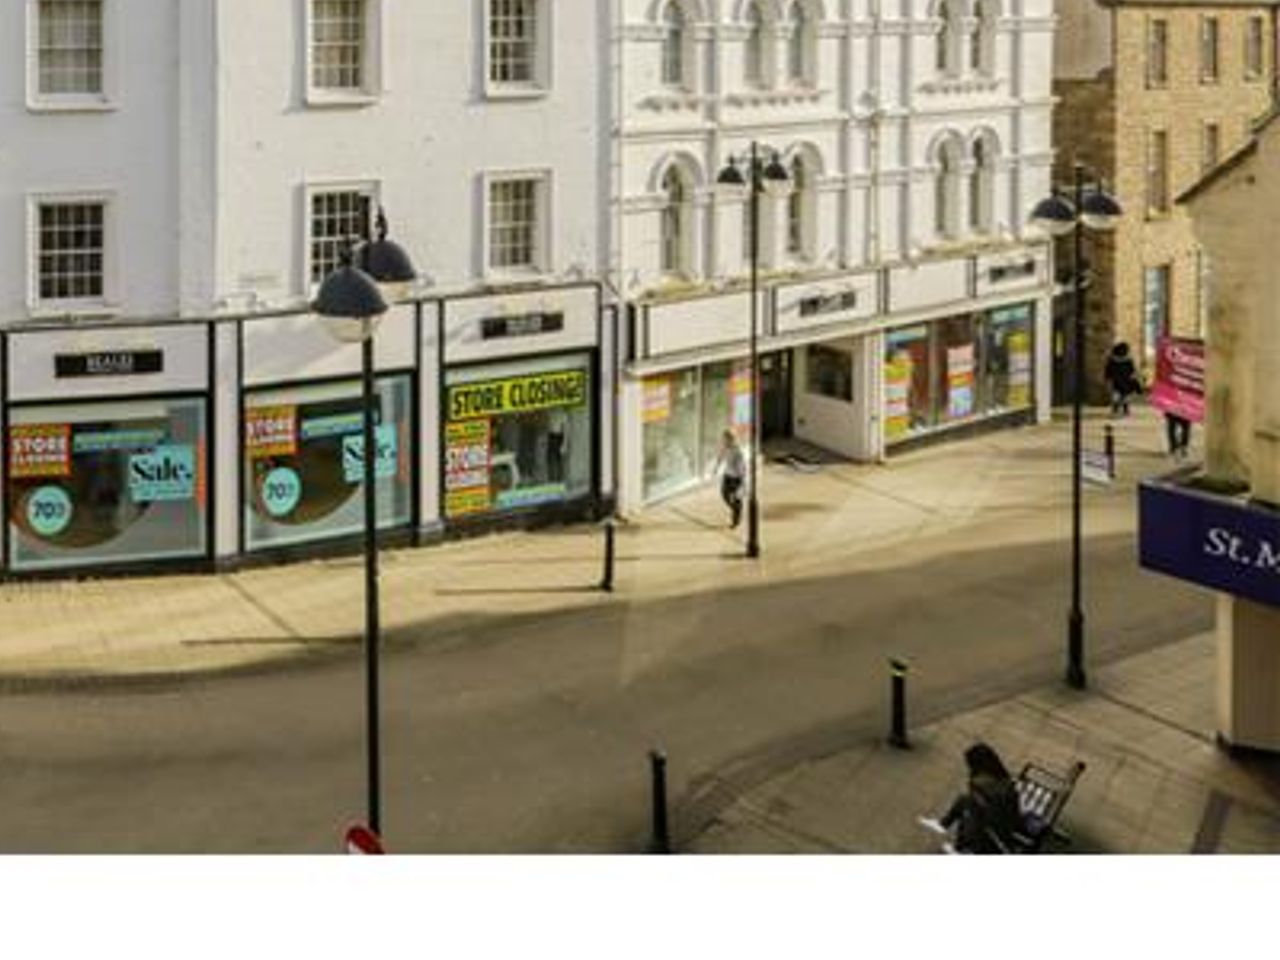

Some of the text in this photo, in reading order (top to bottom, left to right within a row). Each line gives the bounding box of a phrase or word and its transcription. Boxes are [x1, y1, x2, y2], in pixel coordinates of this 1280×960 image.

[454, 384, 503, 416] STORE
[11, 436, 67, 452] STORE
[1203, 528, 1250, 565] St.
